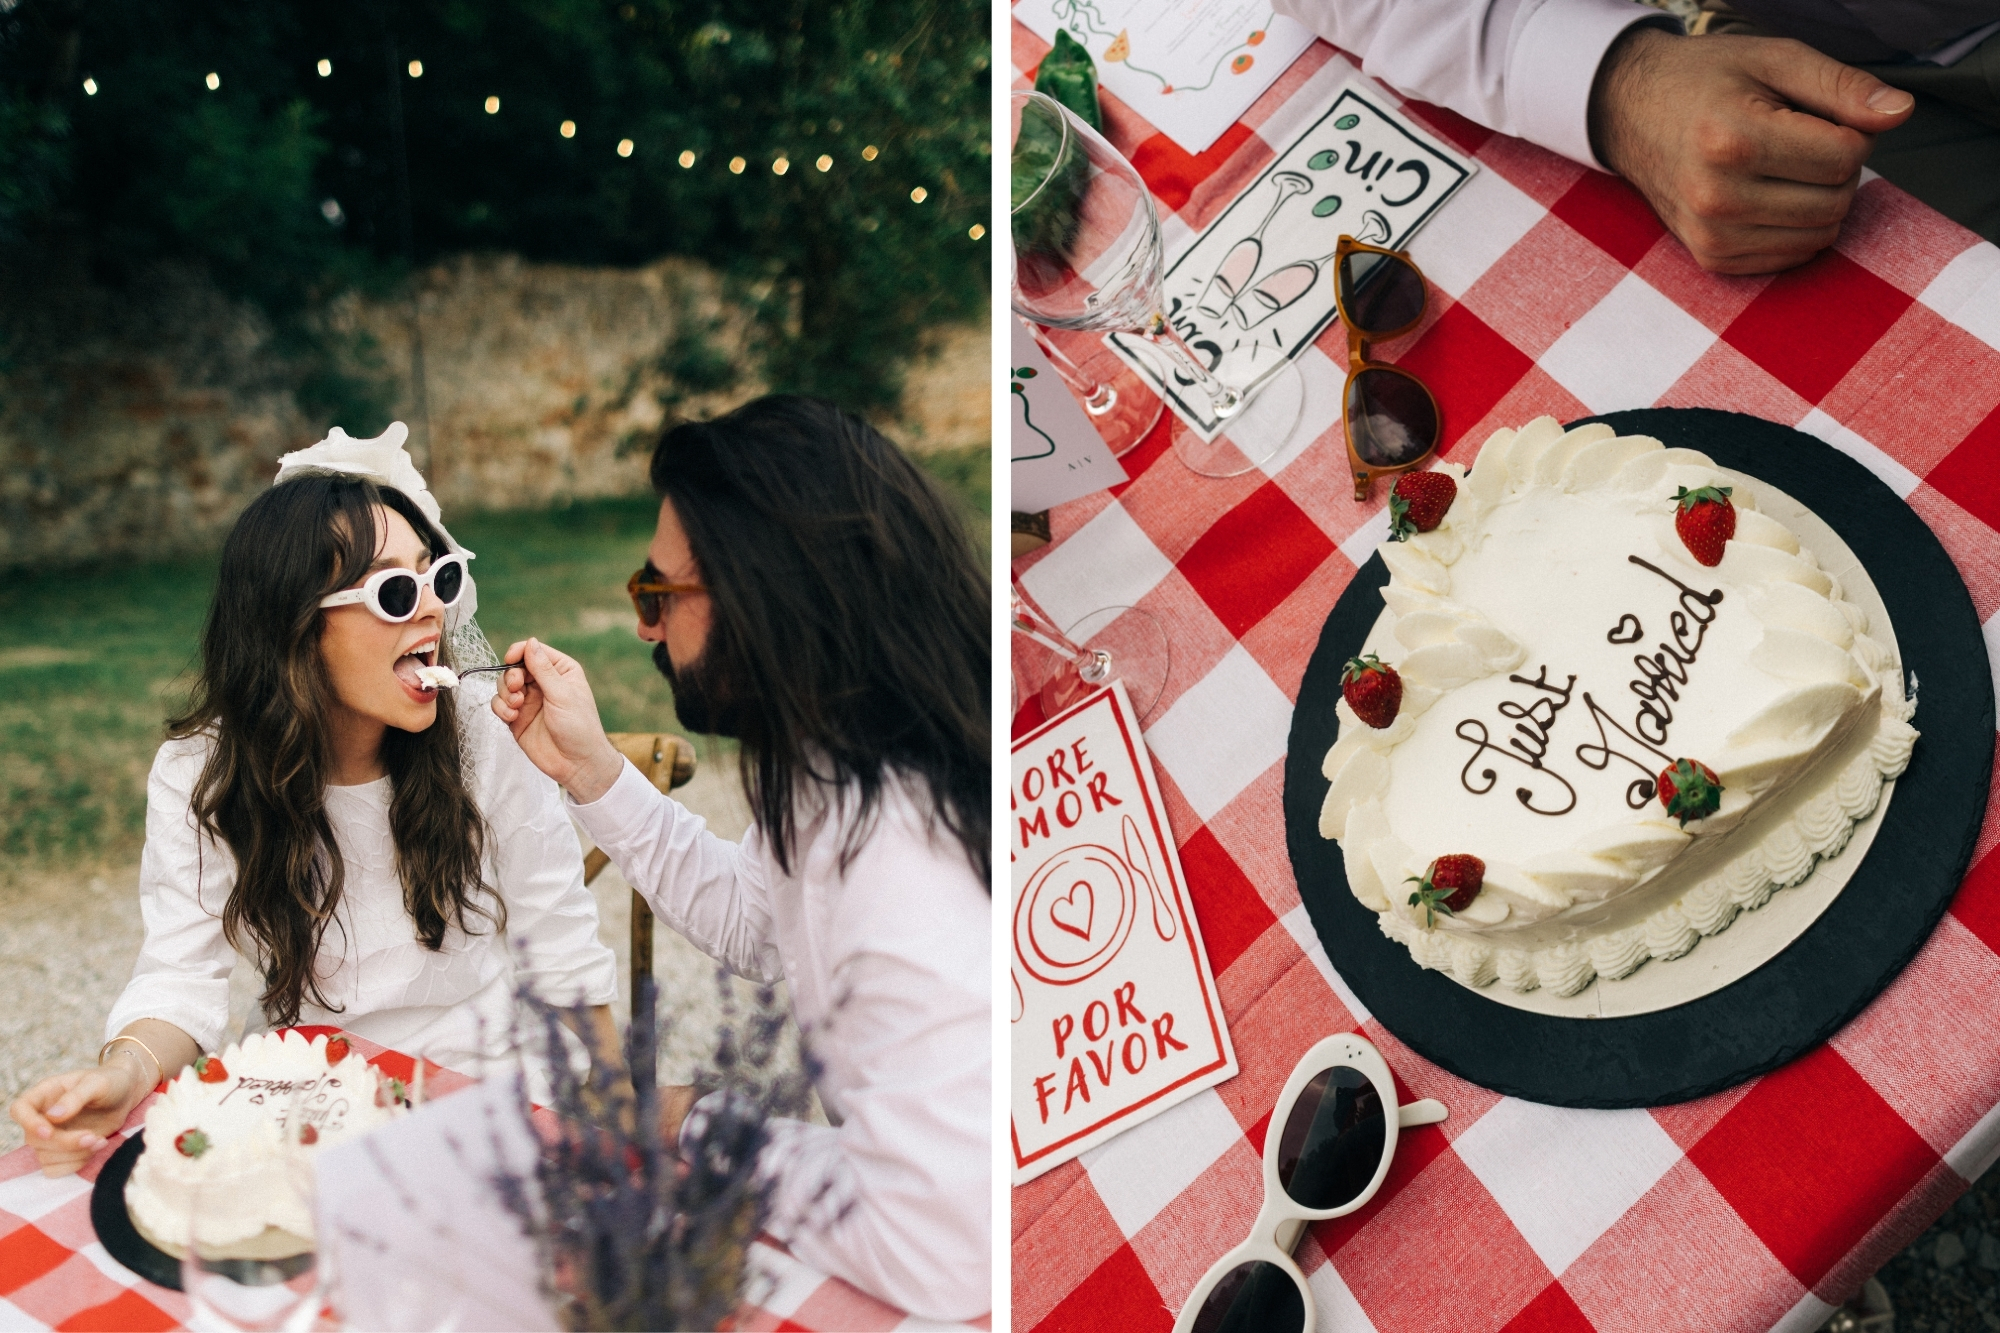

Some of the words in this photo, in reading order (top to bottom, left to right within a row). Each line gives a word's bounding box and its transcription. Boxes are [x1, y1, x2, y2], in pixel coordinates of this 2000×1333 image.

[1345, 140, 1430, 207] Cin
[1575, 554, 1724, 810] Married
[1011, 736, 1094, 811] ORE
[1455, 664, 1578, 816] Just
[1011, 771, 1123, 863] MOR
[1052, 981, 1147, 1060] POR
[1033, 1012, 1189, 1124] FAVOR
